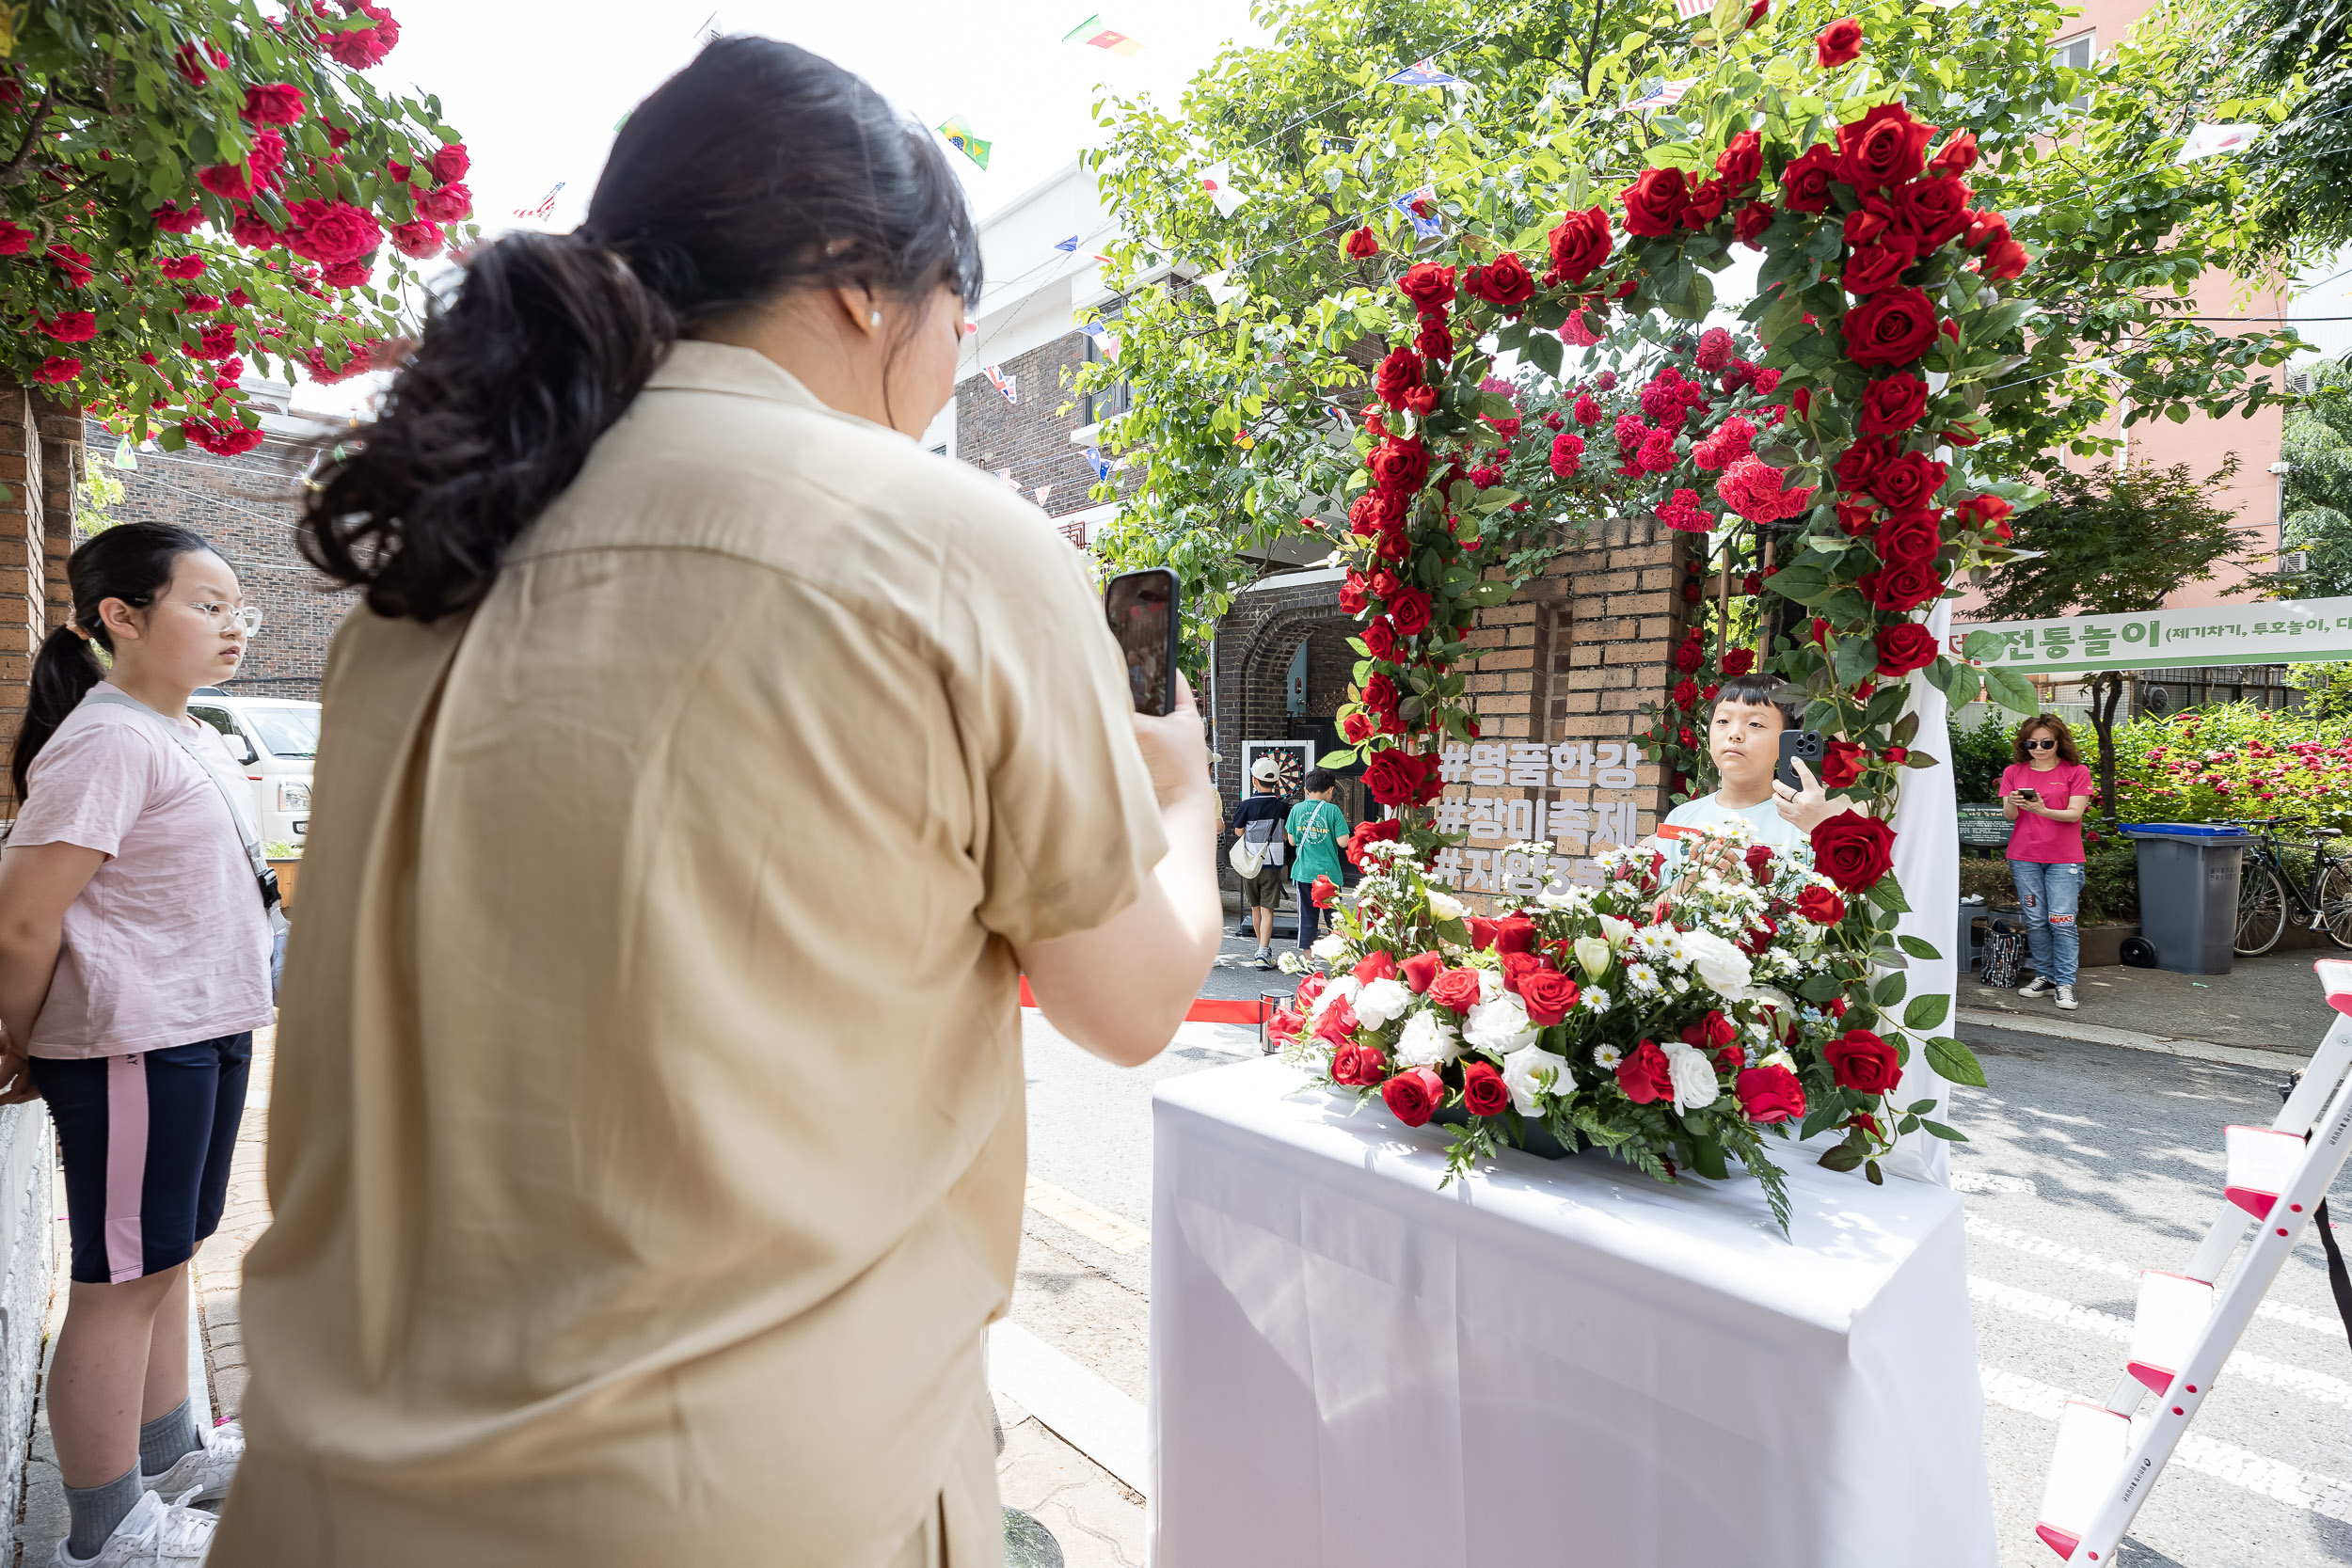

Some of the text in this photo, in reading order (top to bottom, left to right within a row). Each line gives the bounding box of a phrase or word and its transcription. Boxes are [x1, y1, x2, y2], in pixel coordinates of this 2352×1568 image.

[2000, 620, 2160, 661] 전통놀이
[2165, 624, 2248, 642] (제기차기,
[2251, 618, 2330, 636] 투호놀이,
[1437, 743, 1643, 789] #명품한강
[1436, 796, 1638, 847] #장미축제
